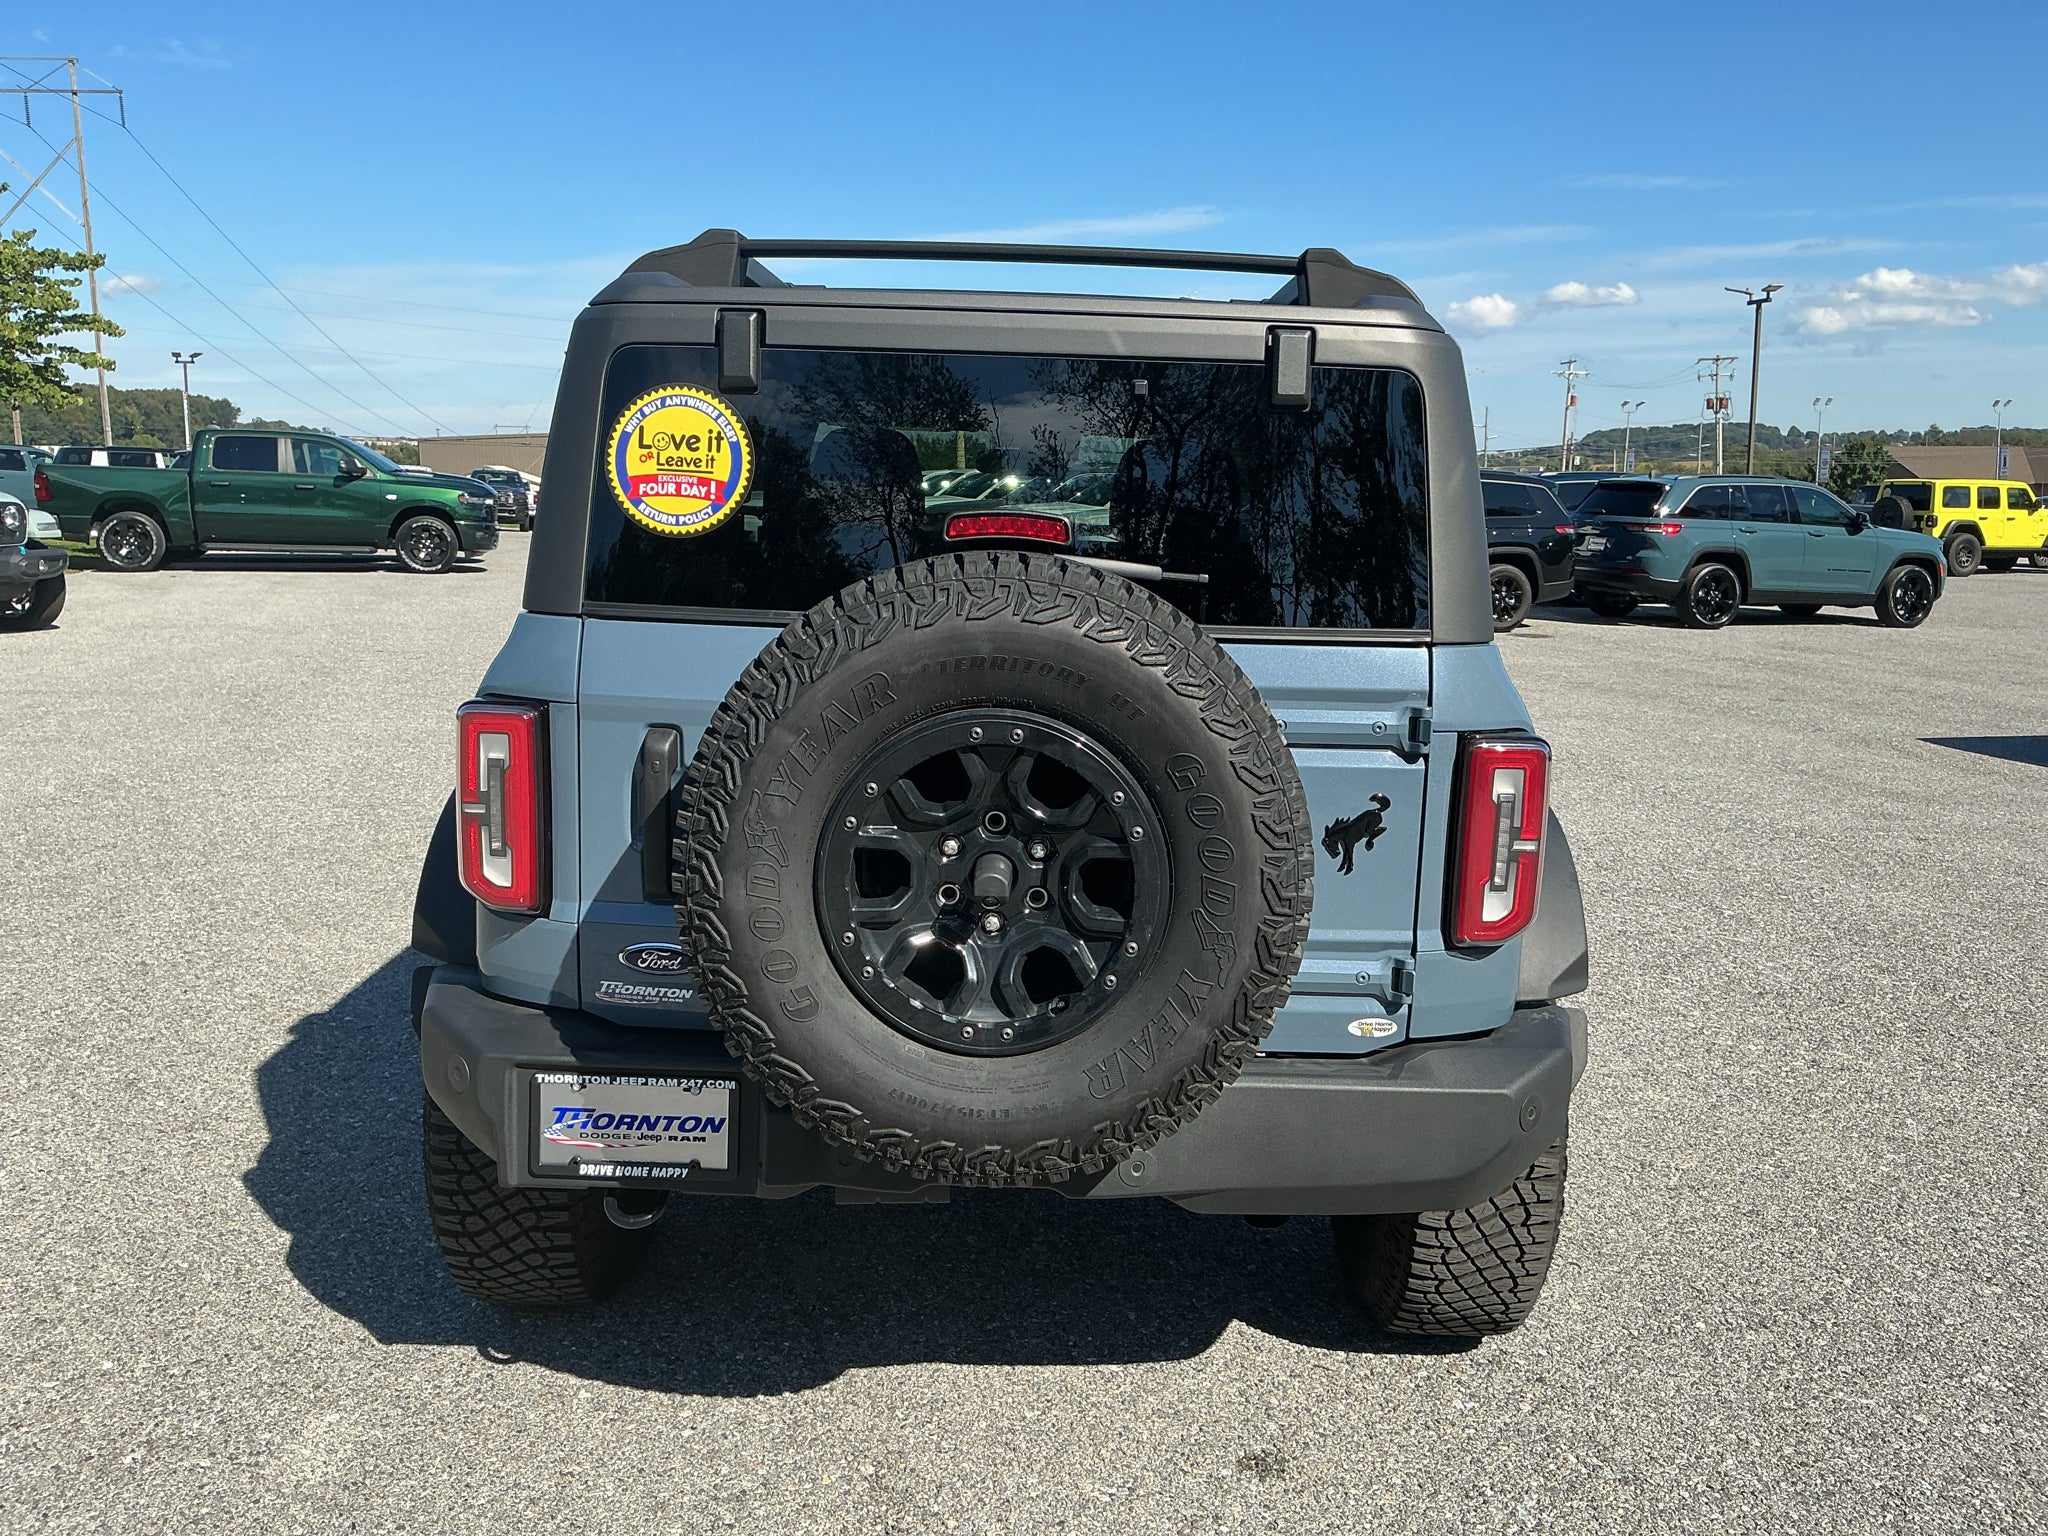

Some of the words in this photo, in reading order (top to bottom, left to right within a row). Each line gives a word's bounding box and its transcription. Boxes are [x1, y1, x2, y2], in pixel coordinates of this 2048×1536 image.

[624, 411, 643, 434] WHY
[644, 399, 662, 415] BUY
[664, 396, 720, 420] ANYWHERE
[717, 414, 738, 442] ELSE?
[707, 429, 724, 453] it
[639, 451, 655, 463] OR
[656, 451, 702, 469] Leave
[705, 454, 716, 469] it
[657, 475, 698, 484] EXCLUSIVE
[638, 483, 676, 495] FOUR
[638, 502, 676, 525] RETURN
[679, 505, 714, 525] POLICY
[937, 655, 1095, 688] TERRITORY
[637, 949, 682, 969] Ford
[600, 980, 693, 998] THORNTON
[551, 1106, 727, 1134] THORNTON
[579, 1132, 631, 1140] DODGE
[636, 1132, 662, 1143] Jeep
[668, 1135, 706, 1143] RAM
[579, 1164, 615, 1176] DRIVE
[615, 1165, 649, 1177] HOME
[651, 1166, 688, 1178] HAPPY
